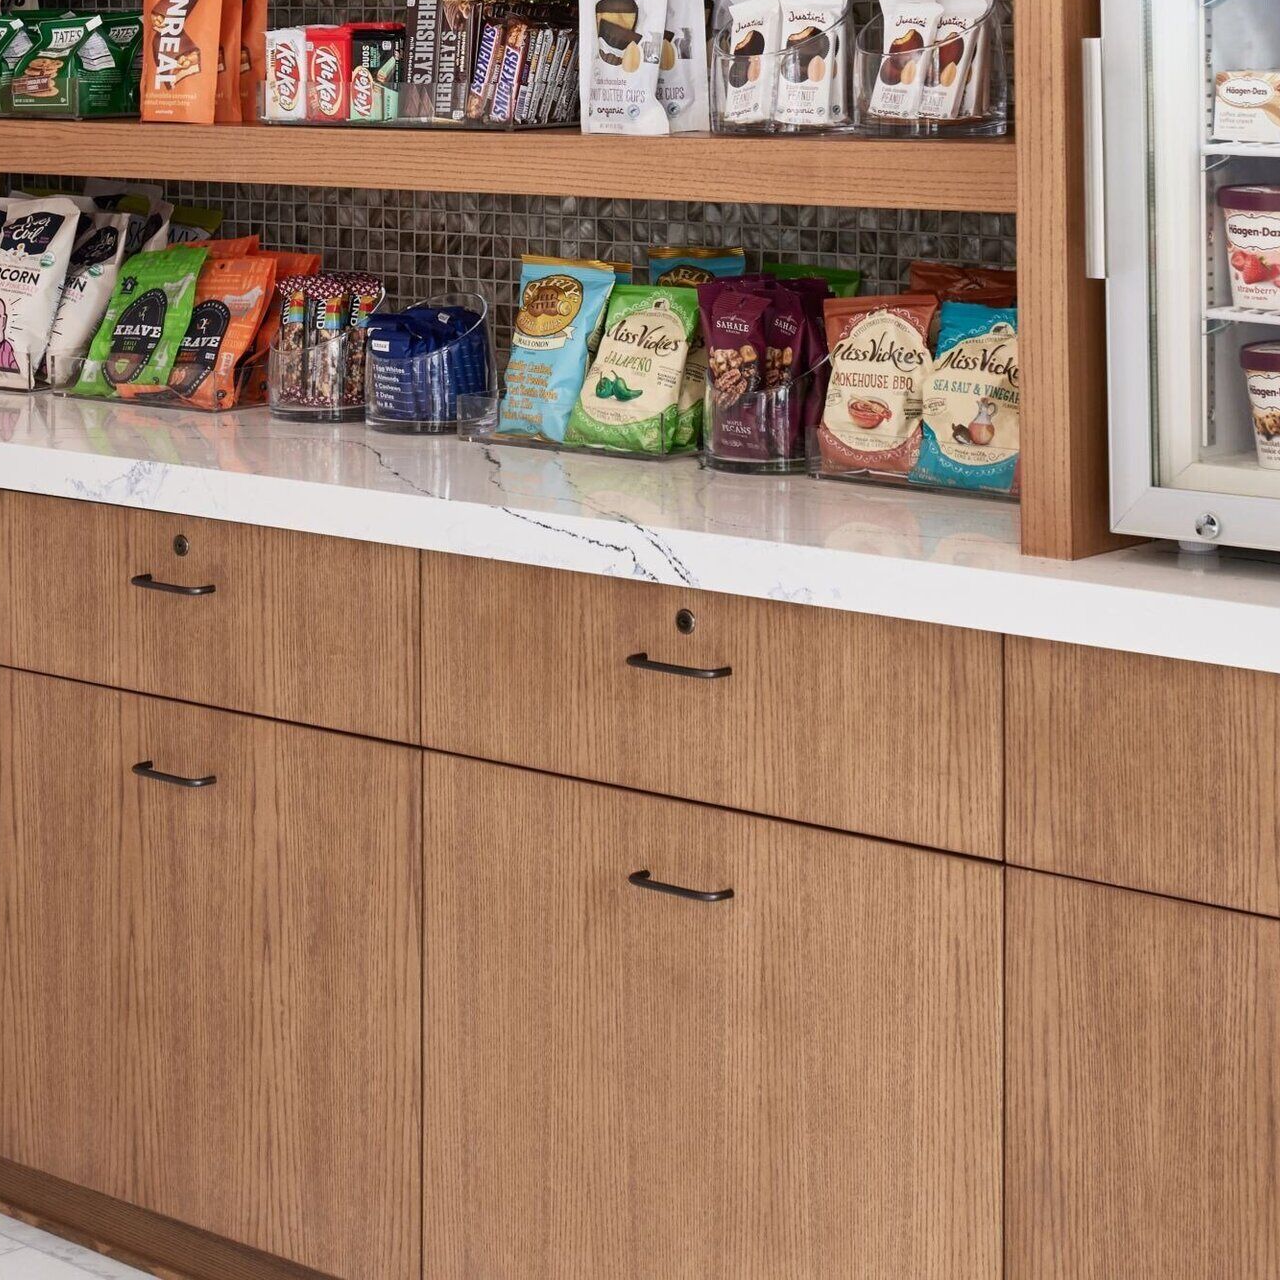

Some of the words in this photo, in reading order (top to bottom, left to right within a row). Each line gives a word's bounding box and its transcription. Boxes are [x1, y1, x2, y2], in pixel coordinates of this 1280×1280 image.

[54, 29, 84, 43] TATE'S
[414, 0, 438, 85] HERSHEY'S
[471, 23, 498, 96] SNICKERS
[436, 31, 457, 113] HERSHEY'S
[491, 46, 522, 120] SNICKERS
[665, 86, 684, 100] CUPS
[597, 107, 625, 119] organic
[13, 225, 38, 243] Evil
[1237, 285, 1278, 295] strawberry
[282, 297, 291, 325] KIND
[316, 298, 327, 330] KIND
[350, 295, 362, 326] KIND
[114, 324, 162, 338] KRAVE
[716, 320, 749, 333] SAHALE
[180, 336, 221, 348] RAVE
[604, 351, 653, 373] JALAPEÑO
[935, 351, 977, 371] Miss
[893, 375, 915, 394] BBQ
[933, 379, 950, 391] SEA
[951, 379, 970, 393] SALT
[974, 385, 981, 395] &
